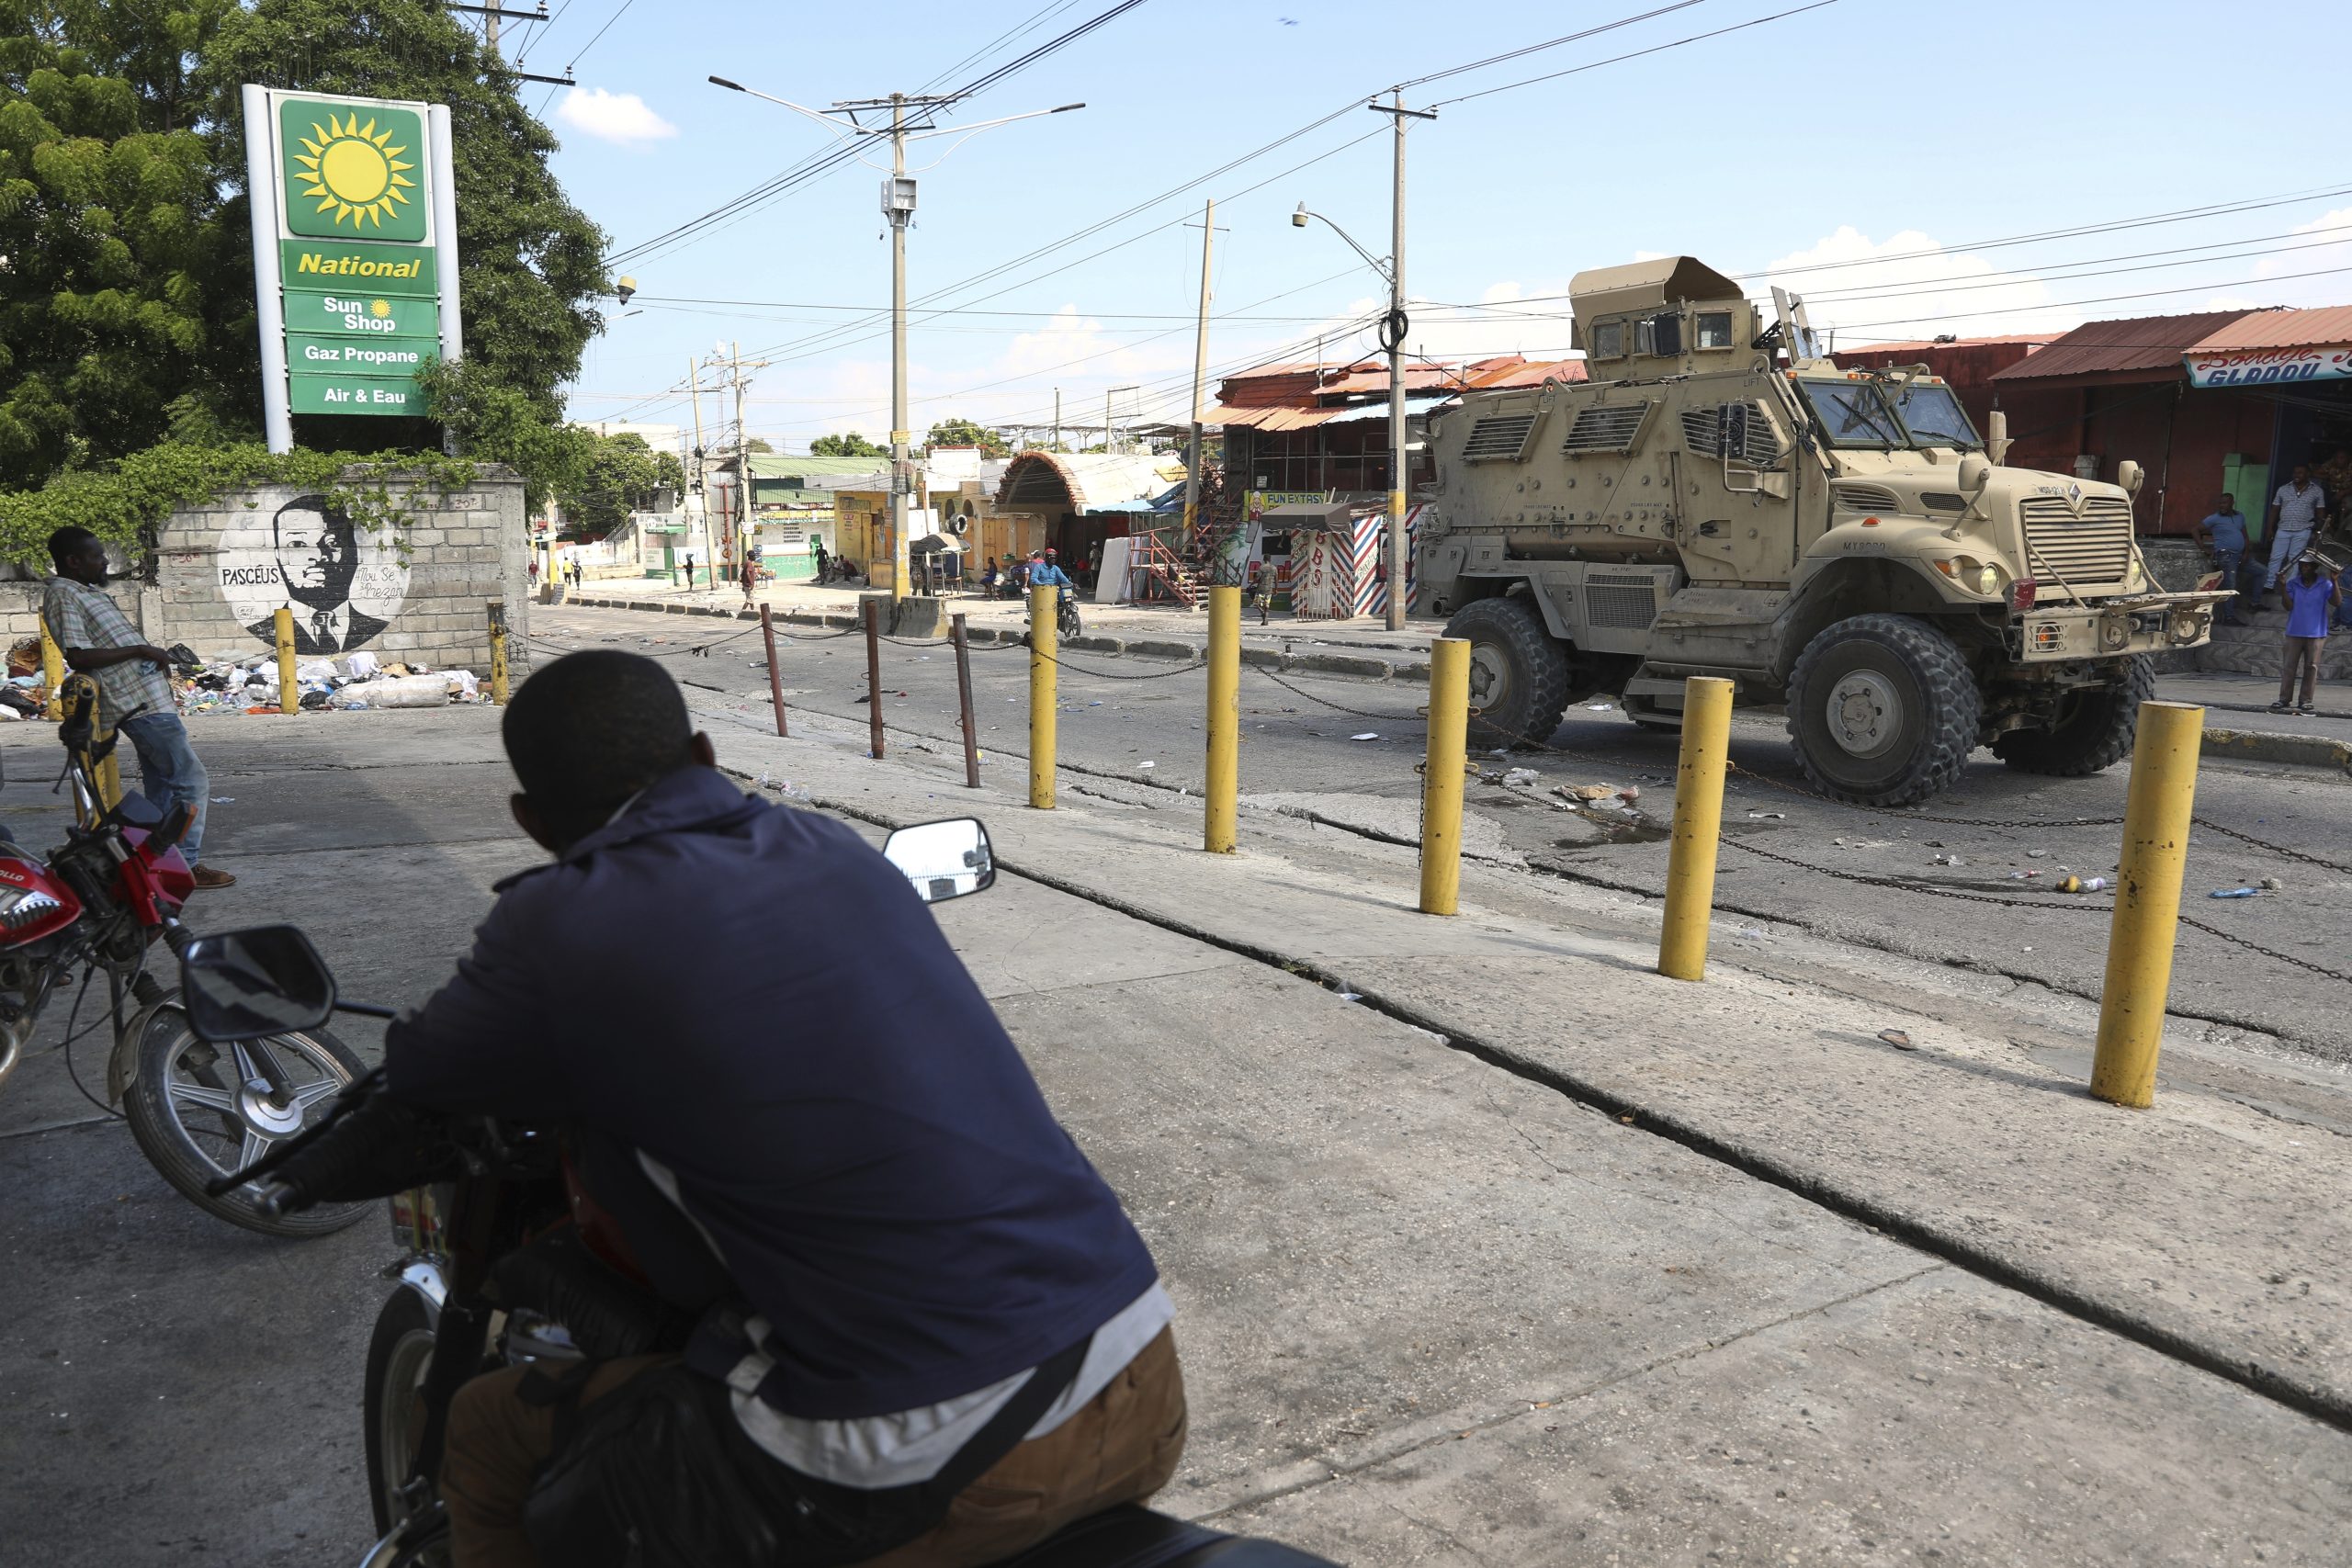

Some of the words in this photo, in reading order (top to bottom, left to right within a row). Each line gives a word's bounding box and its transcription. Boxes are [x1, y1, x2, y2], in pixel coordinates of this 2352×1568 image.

[298, 253, 421, 278] National
[323, 297, 363, 314] Sun
[344, 313, 396, 333] Shop
[304, 345, 340, 360] Gaz
[345, 346, 419, 364] Propane
[1743, 377, 1761, 387] LIFT
[2207, 362, 2322, 387] GLADOU
[323, 388, 350, 402] Air
[355, 389, 368, 402] &
[373, 389, 406, 404] Eau
[1267, 493, 1285, 504] FUN
[1287, 494, 1325, 504] EXTASY
